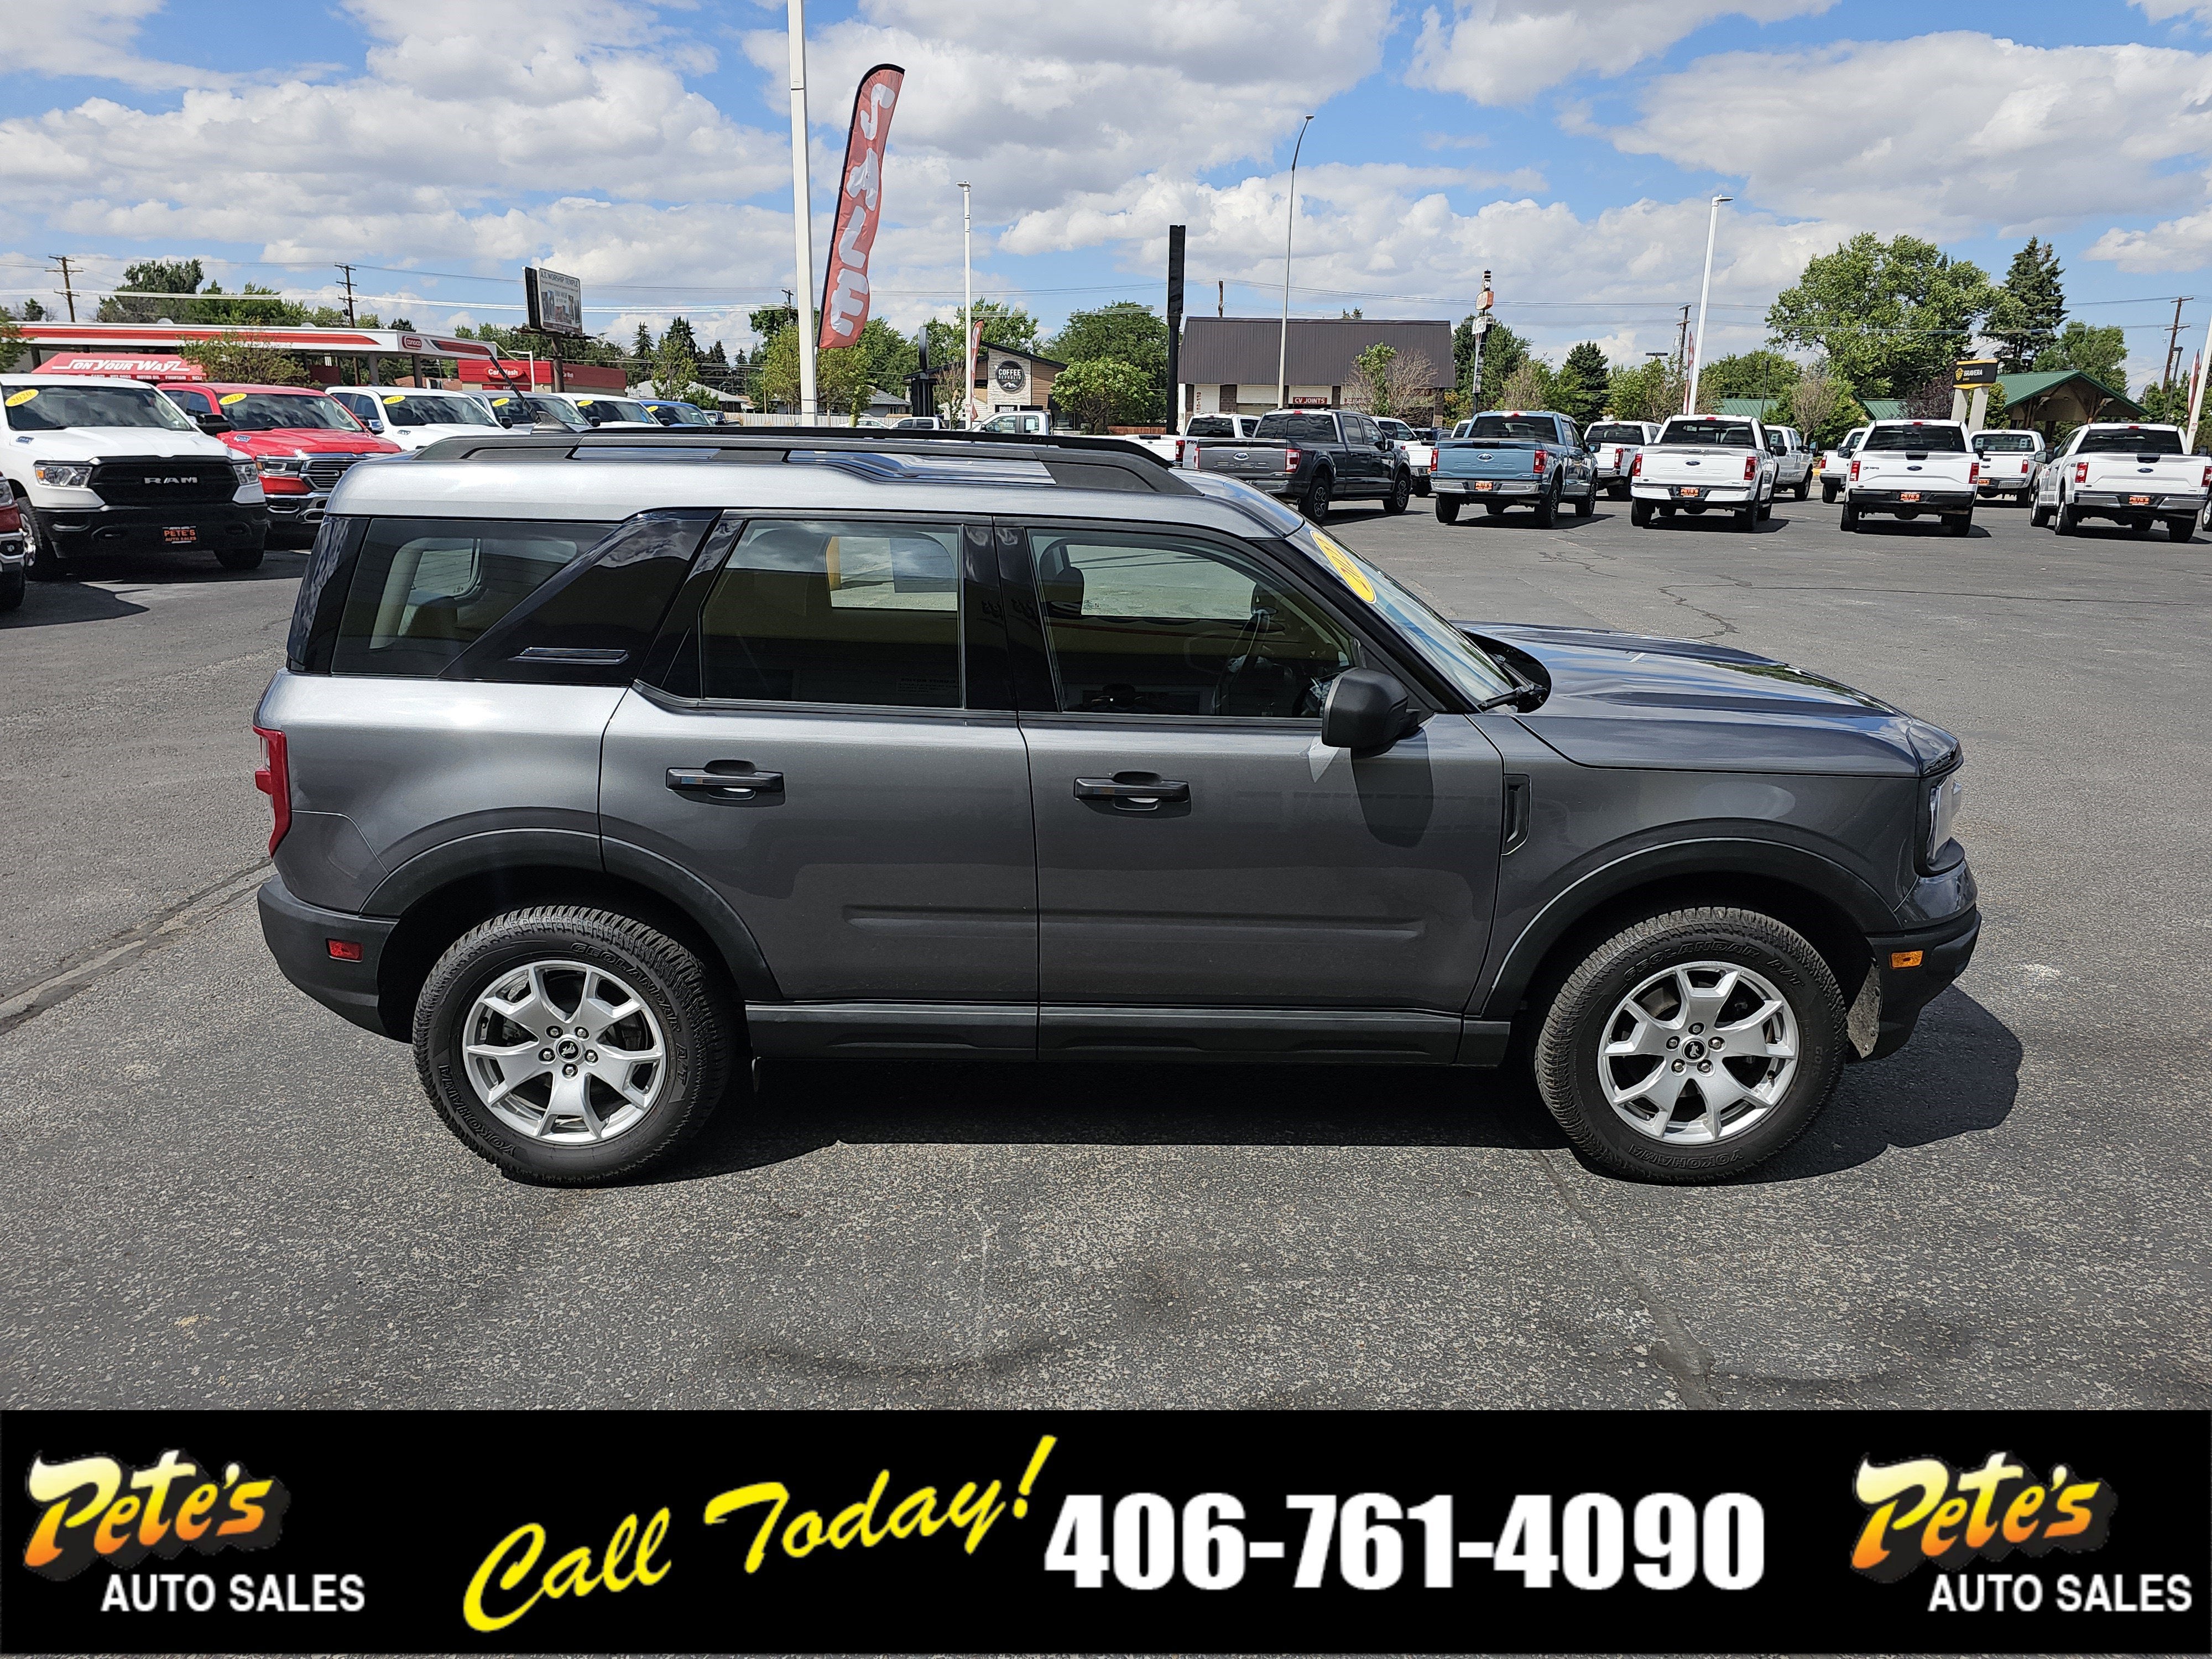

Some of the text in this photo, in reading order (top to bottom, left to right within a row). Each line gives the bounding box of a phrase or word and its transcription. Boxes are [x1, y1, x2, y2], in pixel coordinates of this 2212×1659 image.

[830, 83, 895, 337] SALE
[93, 359, 135, 371] YOUR
[137, 360, 171, 372] WAY
[1623, 941, 1804, 987] GEOLANDAR A/T
[570, 942, 690, 1086] GEOLANDAR A/T
[438, 1064, 517, 1157] YOKOHAMA
[1628, 1143, 1744, 1169] YOKOHAMA
